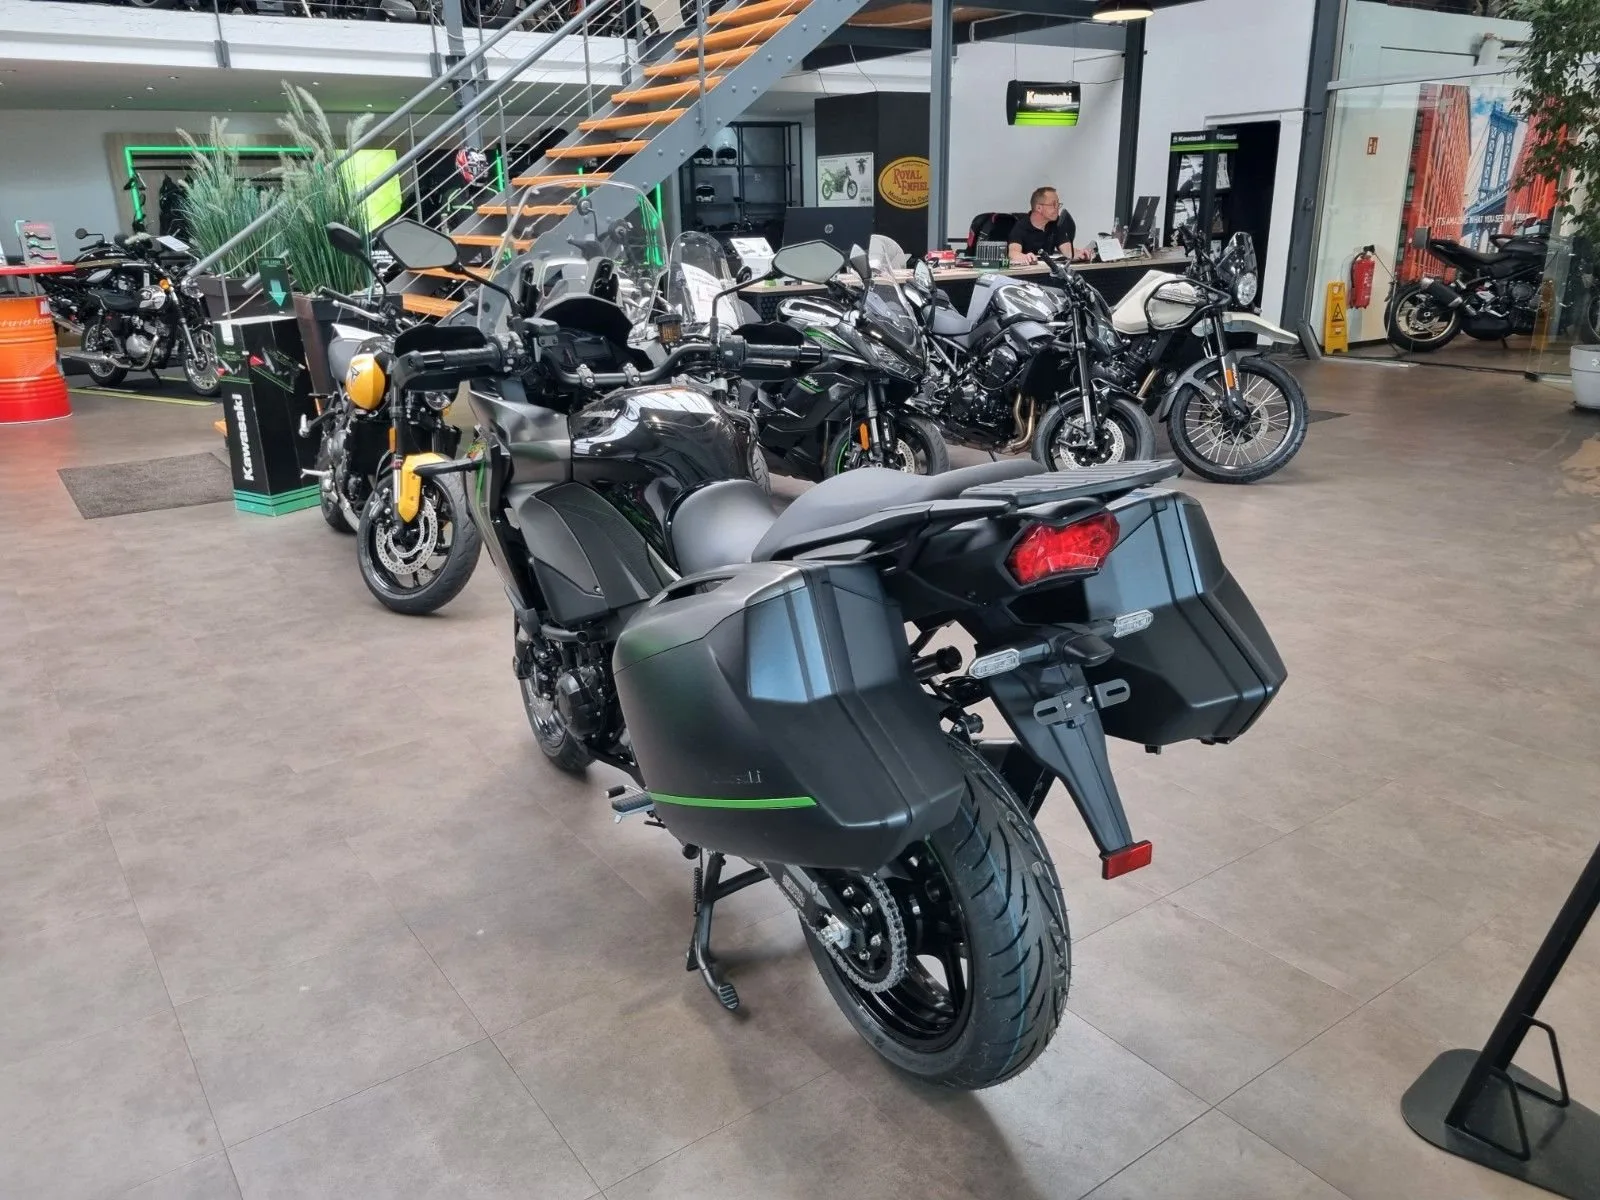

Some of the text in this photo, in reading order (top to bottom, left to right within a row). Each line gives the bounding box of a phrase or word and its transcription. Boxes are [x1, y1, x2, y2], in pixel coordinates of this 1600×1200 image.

[892, 168, 923, 188] ROYAL
[900, 180, 929, 196] ENFIEL
[1469, 215, 1483, 223] WHAT
[231, 393, 254, 481] Kawasaki
